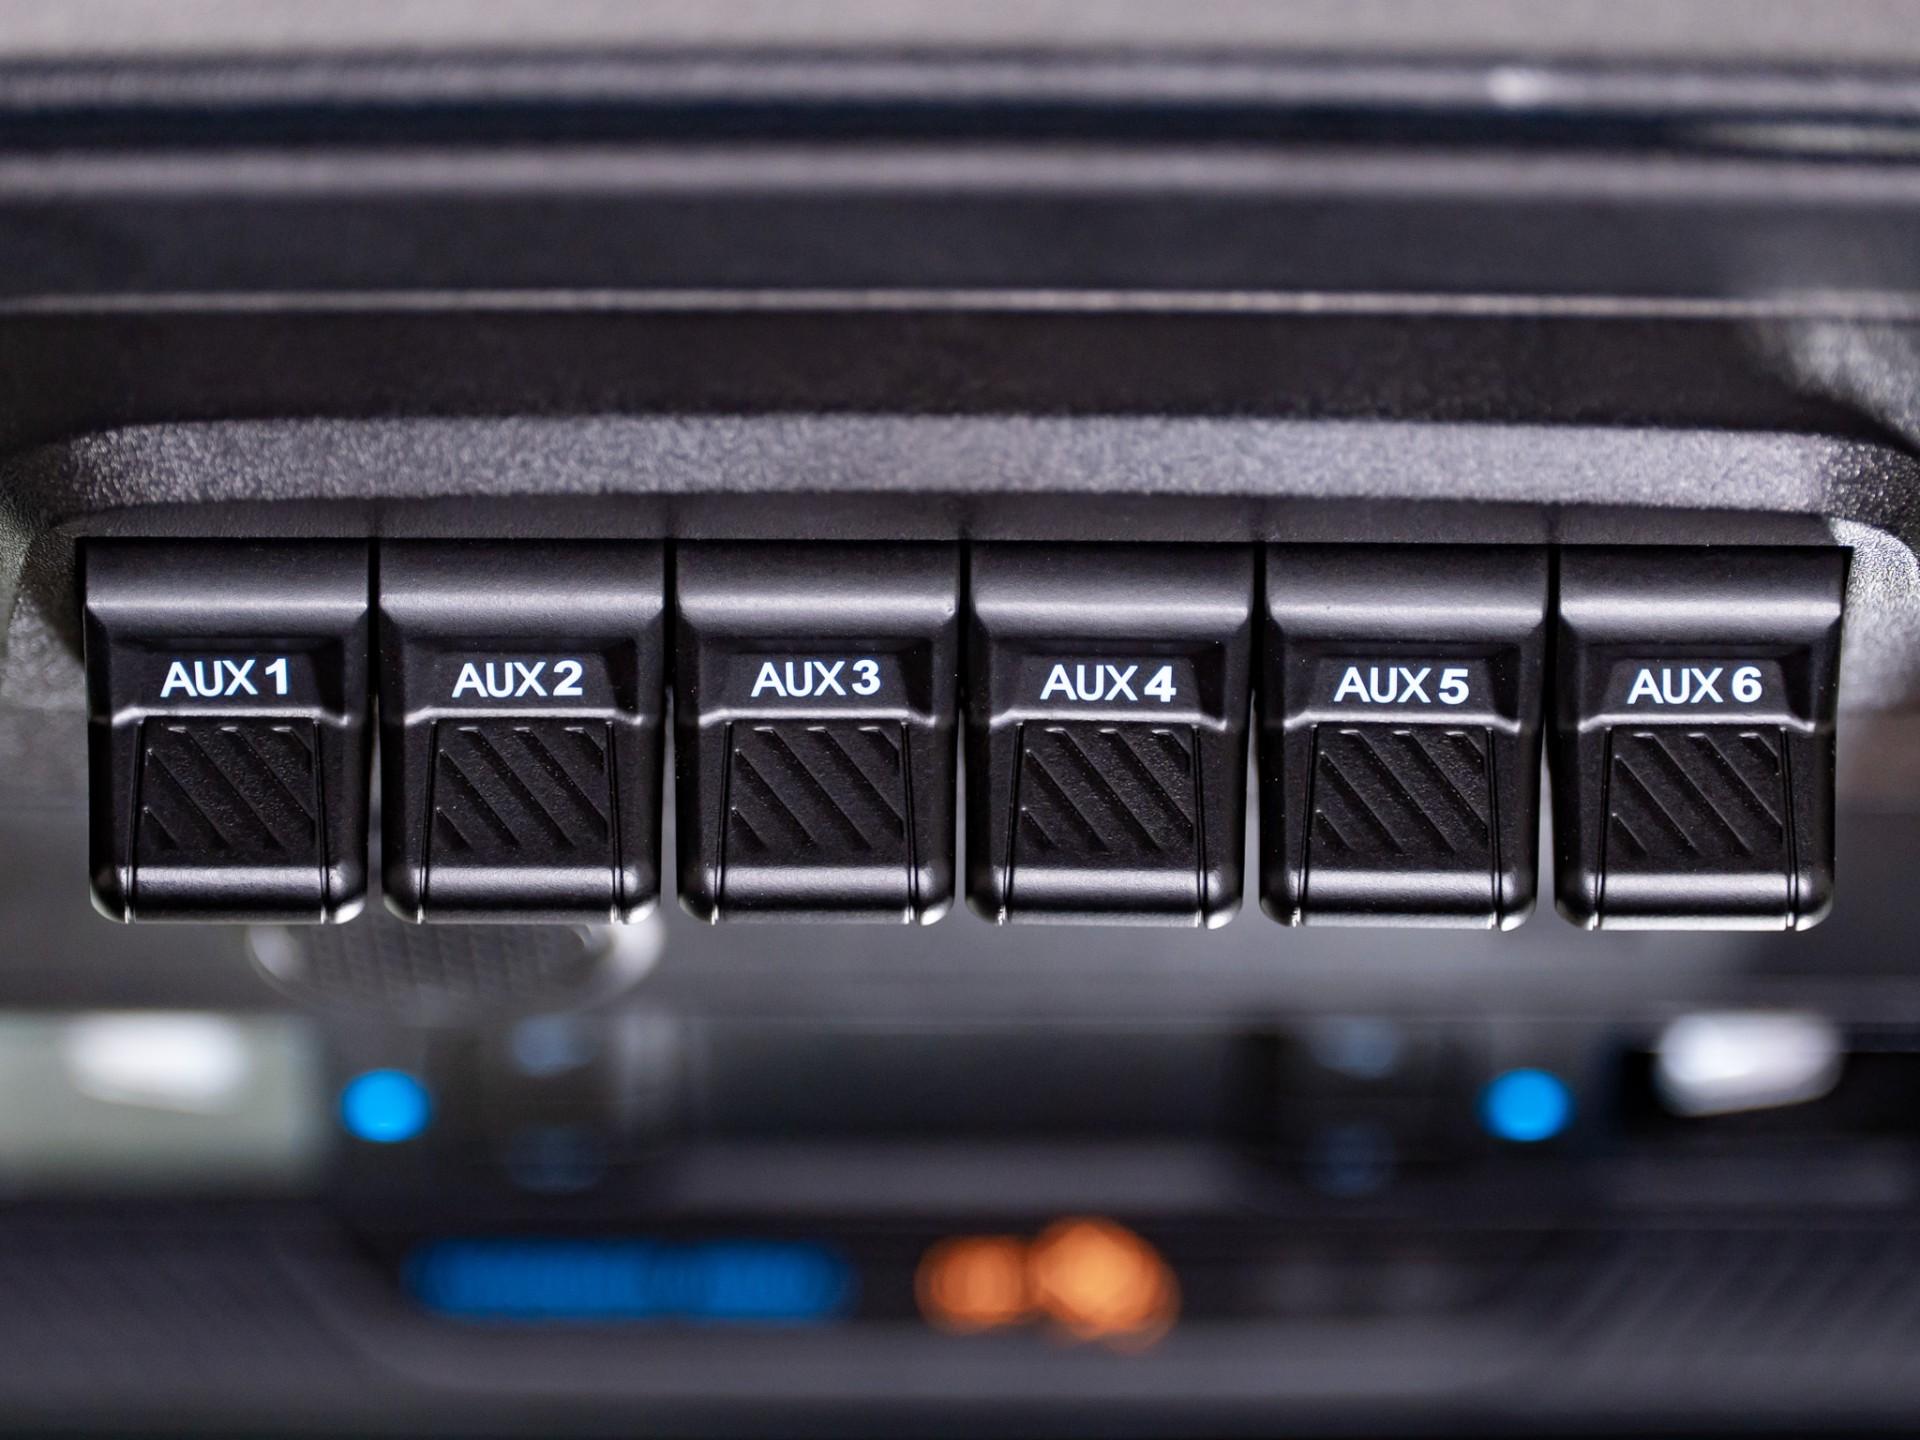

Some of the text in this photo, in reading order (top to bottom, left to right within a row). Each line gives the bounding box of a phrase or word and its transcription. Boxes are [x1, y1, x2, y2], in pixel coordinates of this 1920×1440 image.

[160, 659, 259, 698] AUX
[451, 661, 548, 698] AUX
[750, 660, 847, 698] AUX
[1039, 663, 1139, 702] AUX
[1333, 666, 1432, 704] AUX
[1626, 667, 1724, 705] AUX
